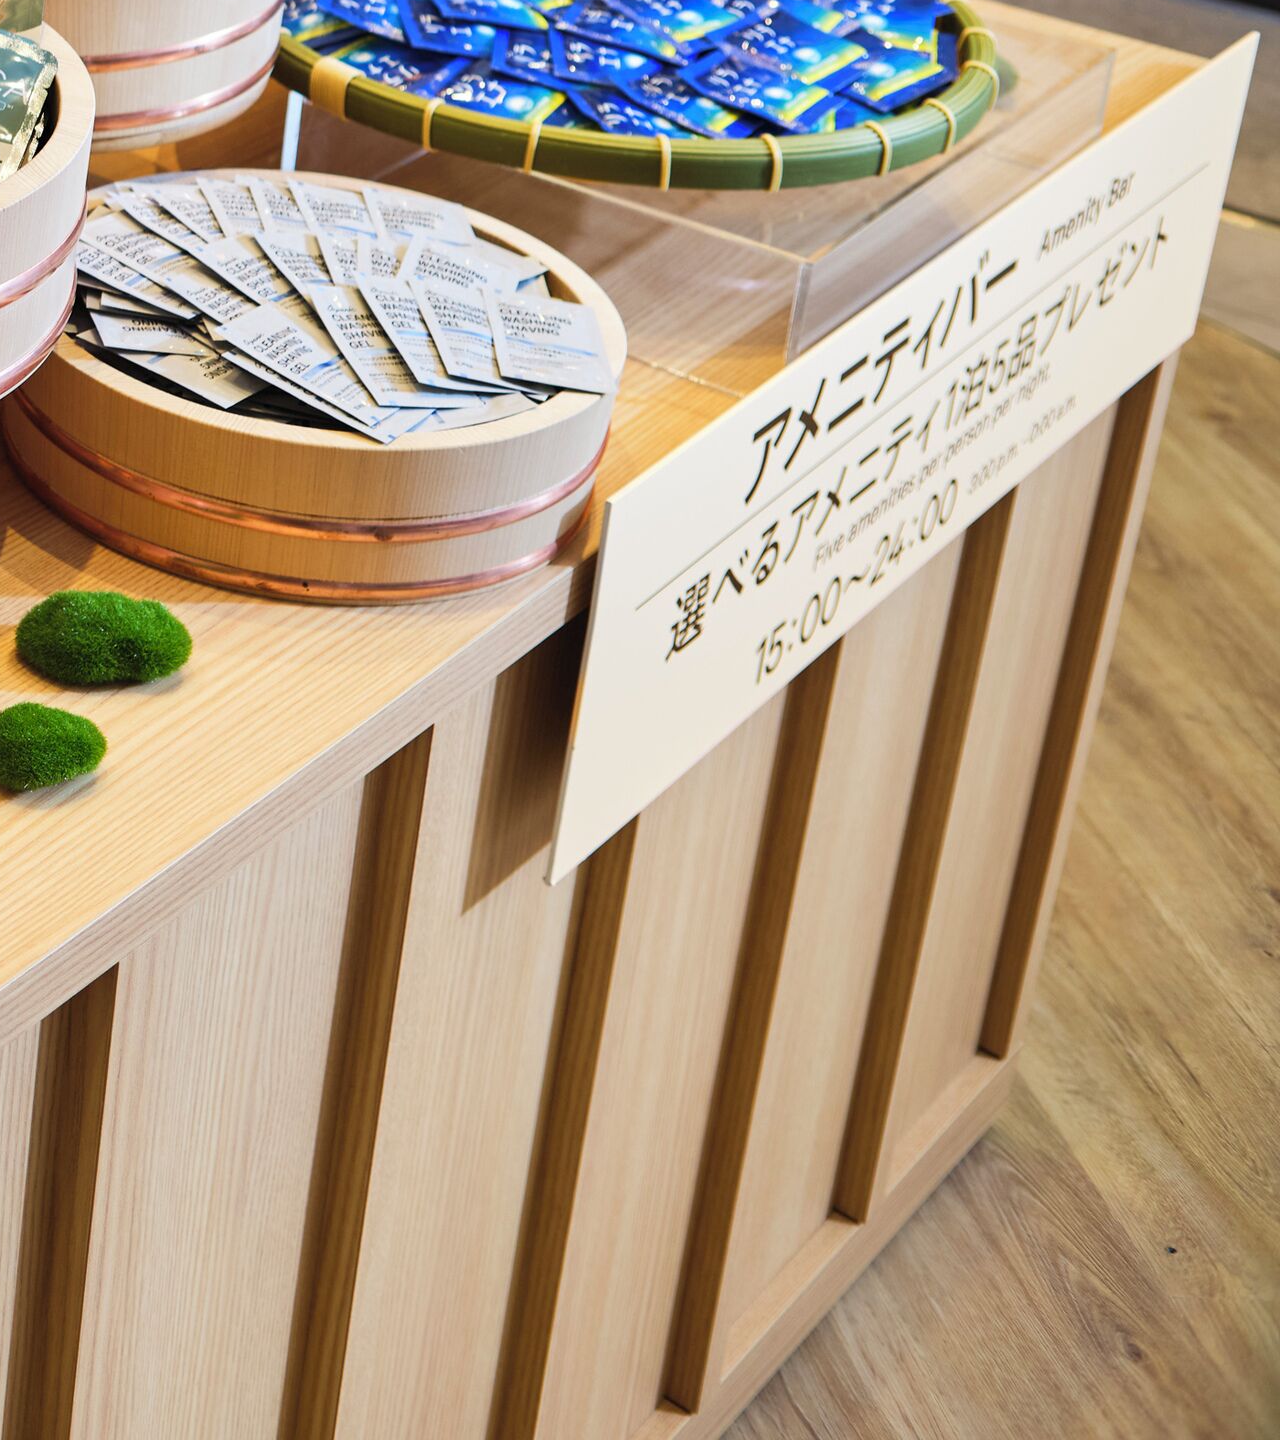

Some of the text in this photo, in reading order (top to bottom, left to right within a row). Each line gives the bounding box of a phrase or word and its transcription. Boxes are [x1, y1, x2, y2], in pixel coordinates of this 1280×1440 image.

[1039, 172, 1136, 258] Amenity Bar
[289, 362, 311, 375] GEL
[348, 339, 376, 350] GEL
[744, 247, 1020, 505] アメニティバー
[813, 534, 844, 572] Five
[847, 476, 916, 544] amenities
[919, 455, 944, 486] per
[943, 413, 994, 468] person
[993, 394, 1014, 426] per
